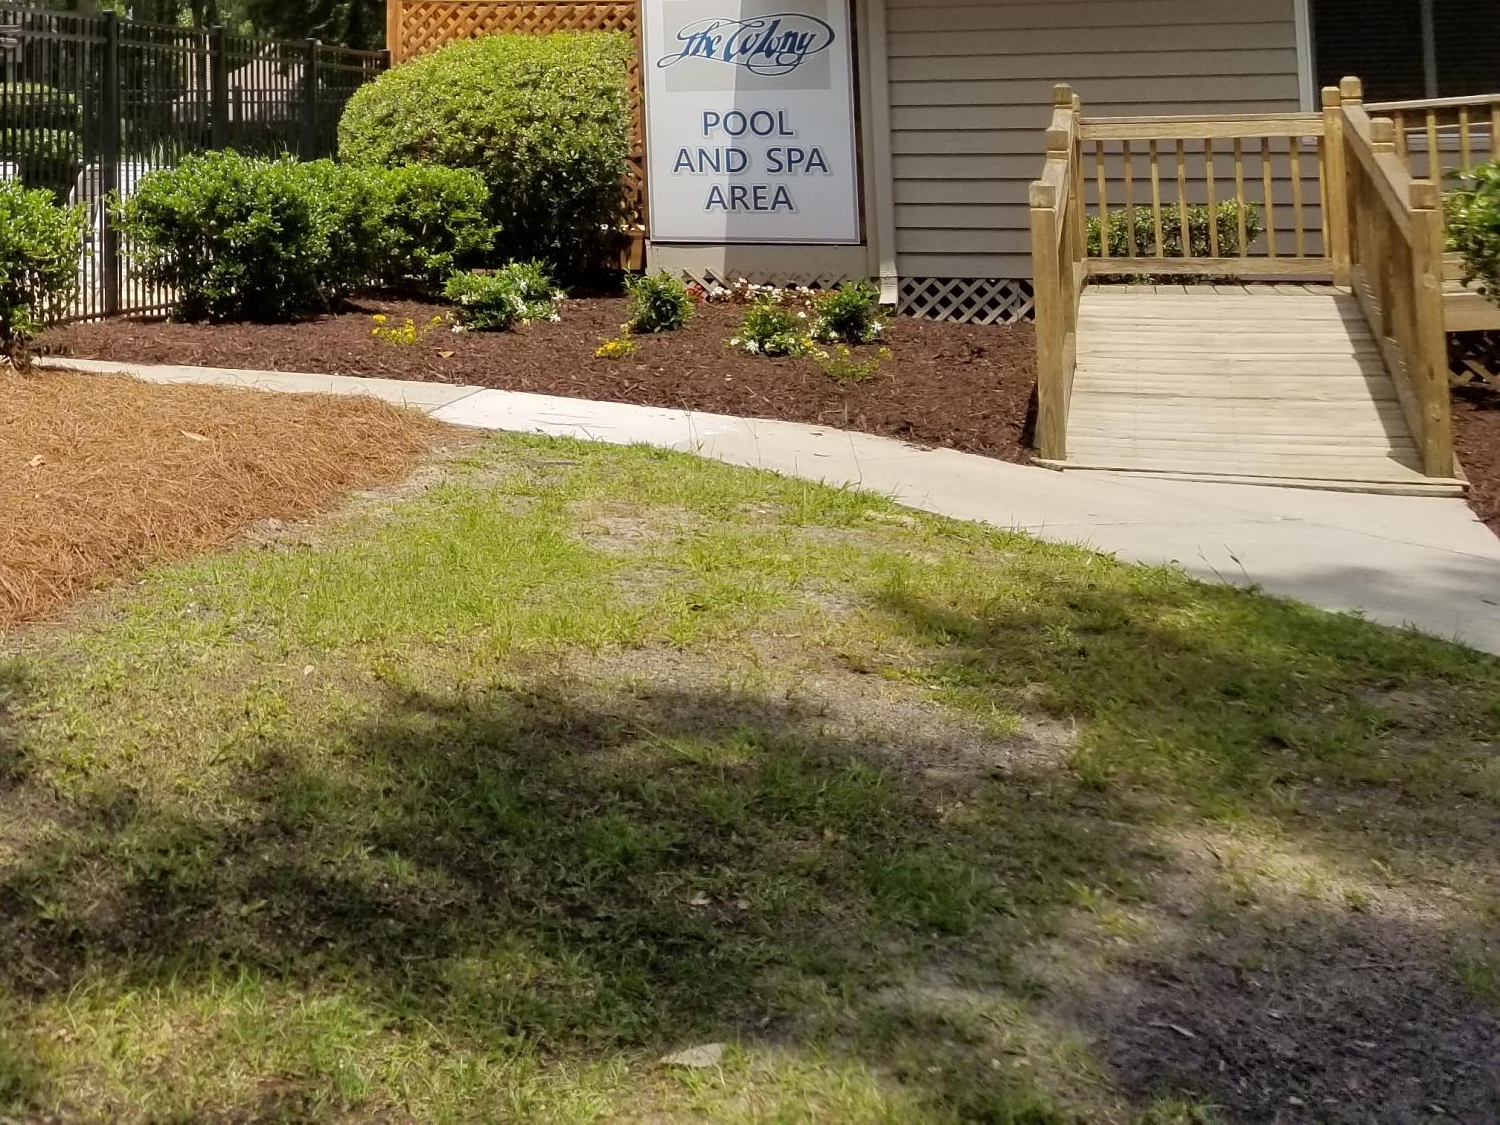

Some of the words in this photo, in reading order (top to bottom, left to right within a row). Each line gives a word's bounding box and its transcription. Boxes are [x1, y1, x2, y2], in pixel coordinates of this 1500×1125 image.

[723, 13, 835, 76] Colony
[703, 111, 794, 136] POOL
[673, 148, 748, 173] AND
[766, 148, 829, 173] SPA
[705, 185, 794, 211] AREA
